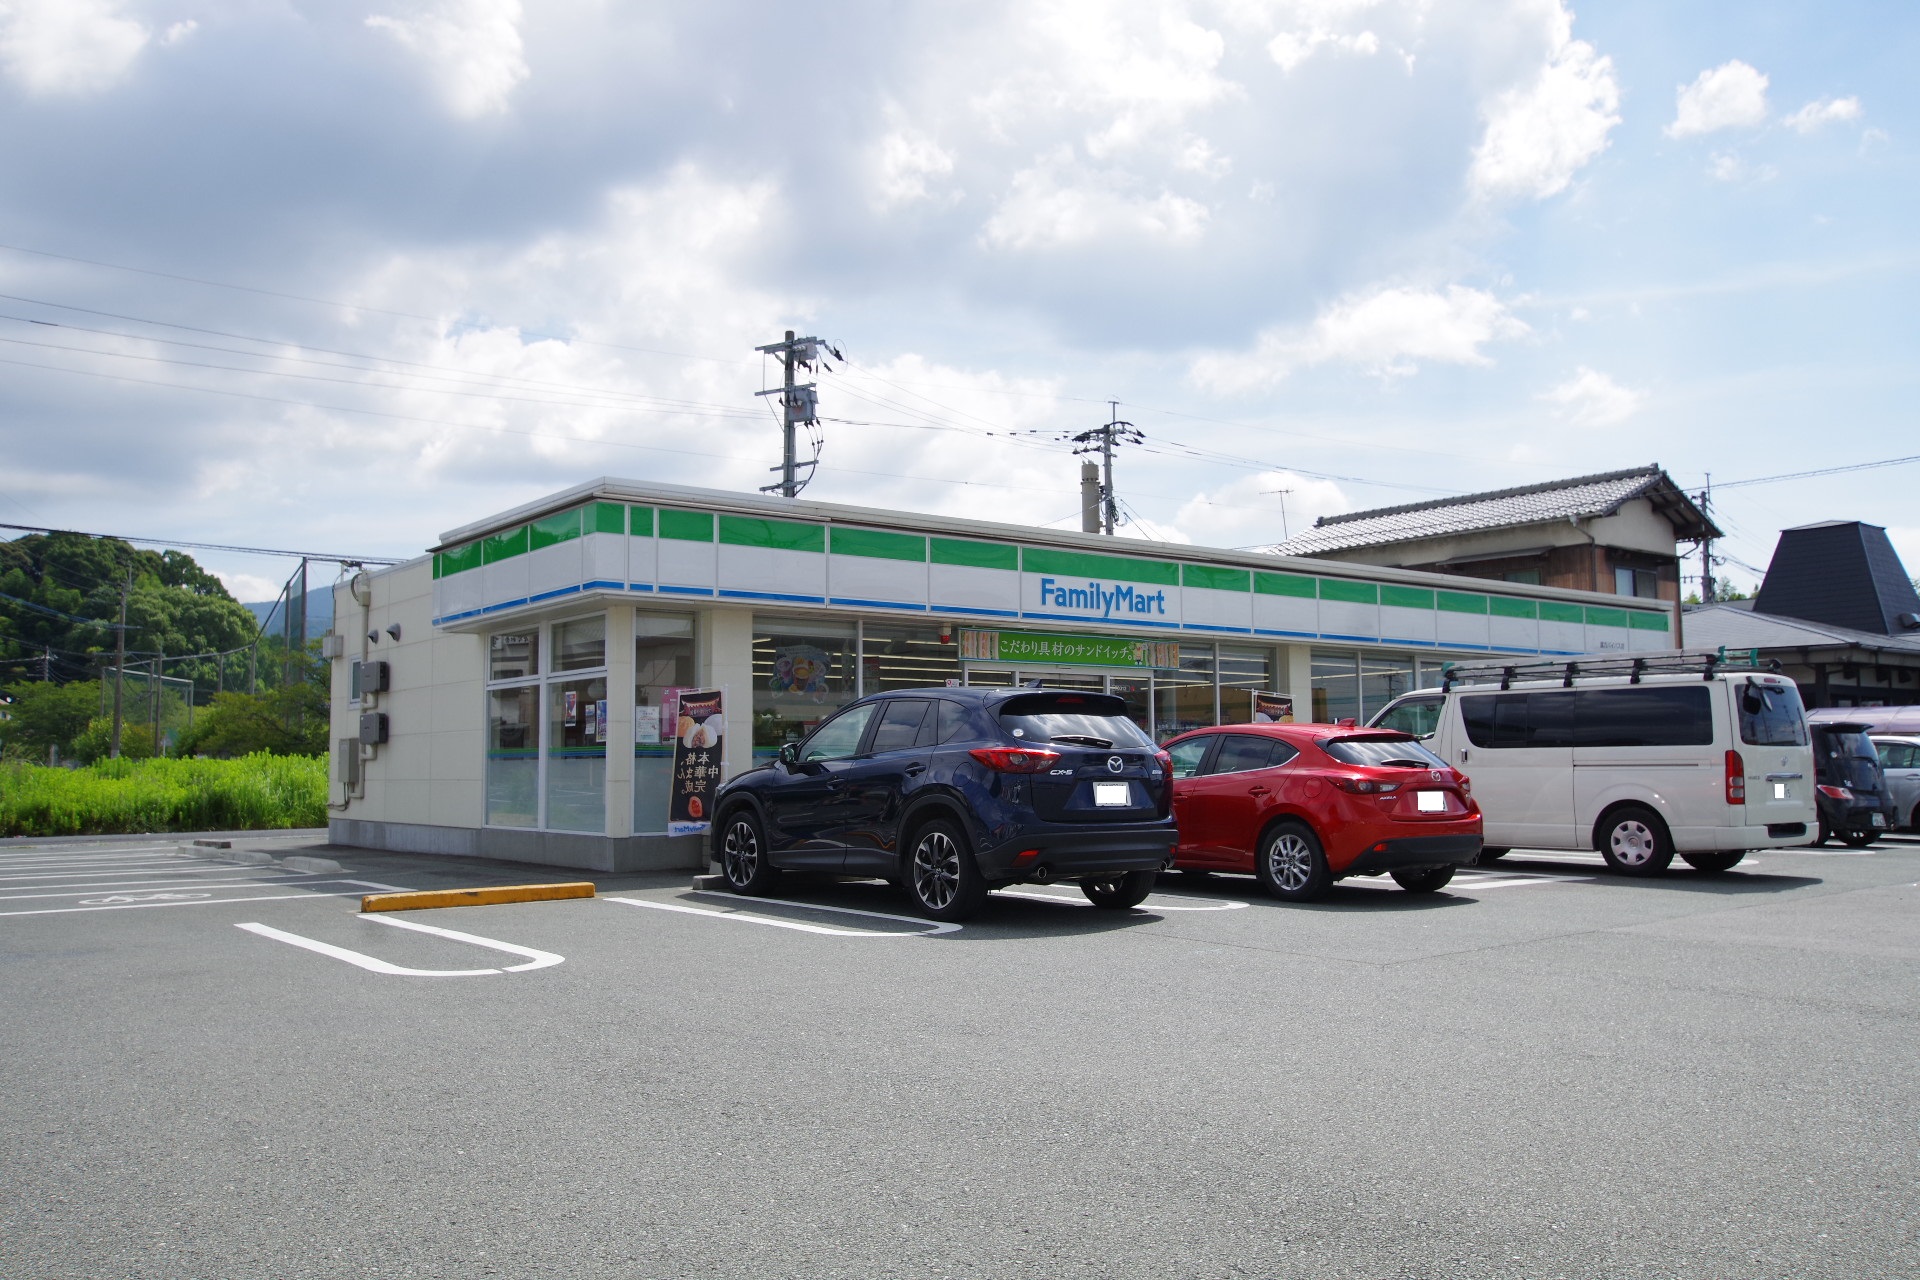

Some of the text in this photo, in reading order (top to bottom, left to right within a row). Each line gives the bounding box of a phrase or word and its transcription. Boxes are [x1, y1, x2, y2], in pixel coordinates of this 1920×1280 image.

[1041, 578, 1165, 618] FamilyMart
[1000, 639, 1133, 661] こだわり具材のサンドイッチ。
